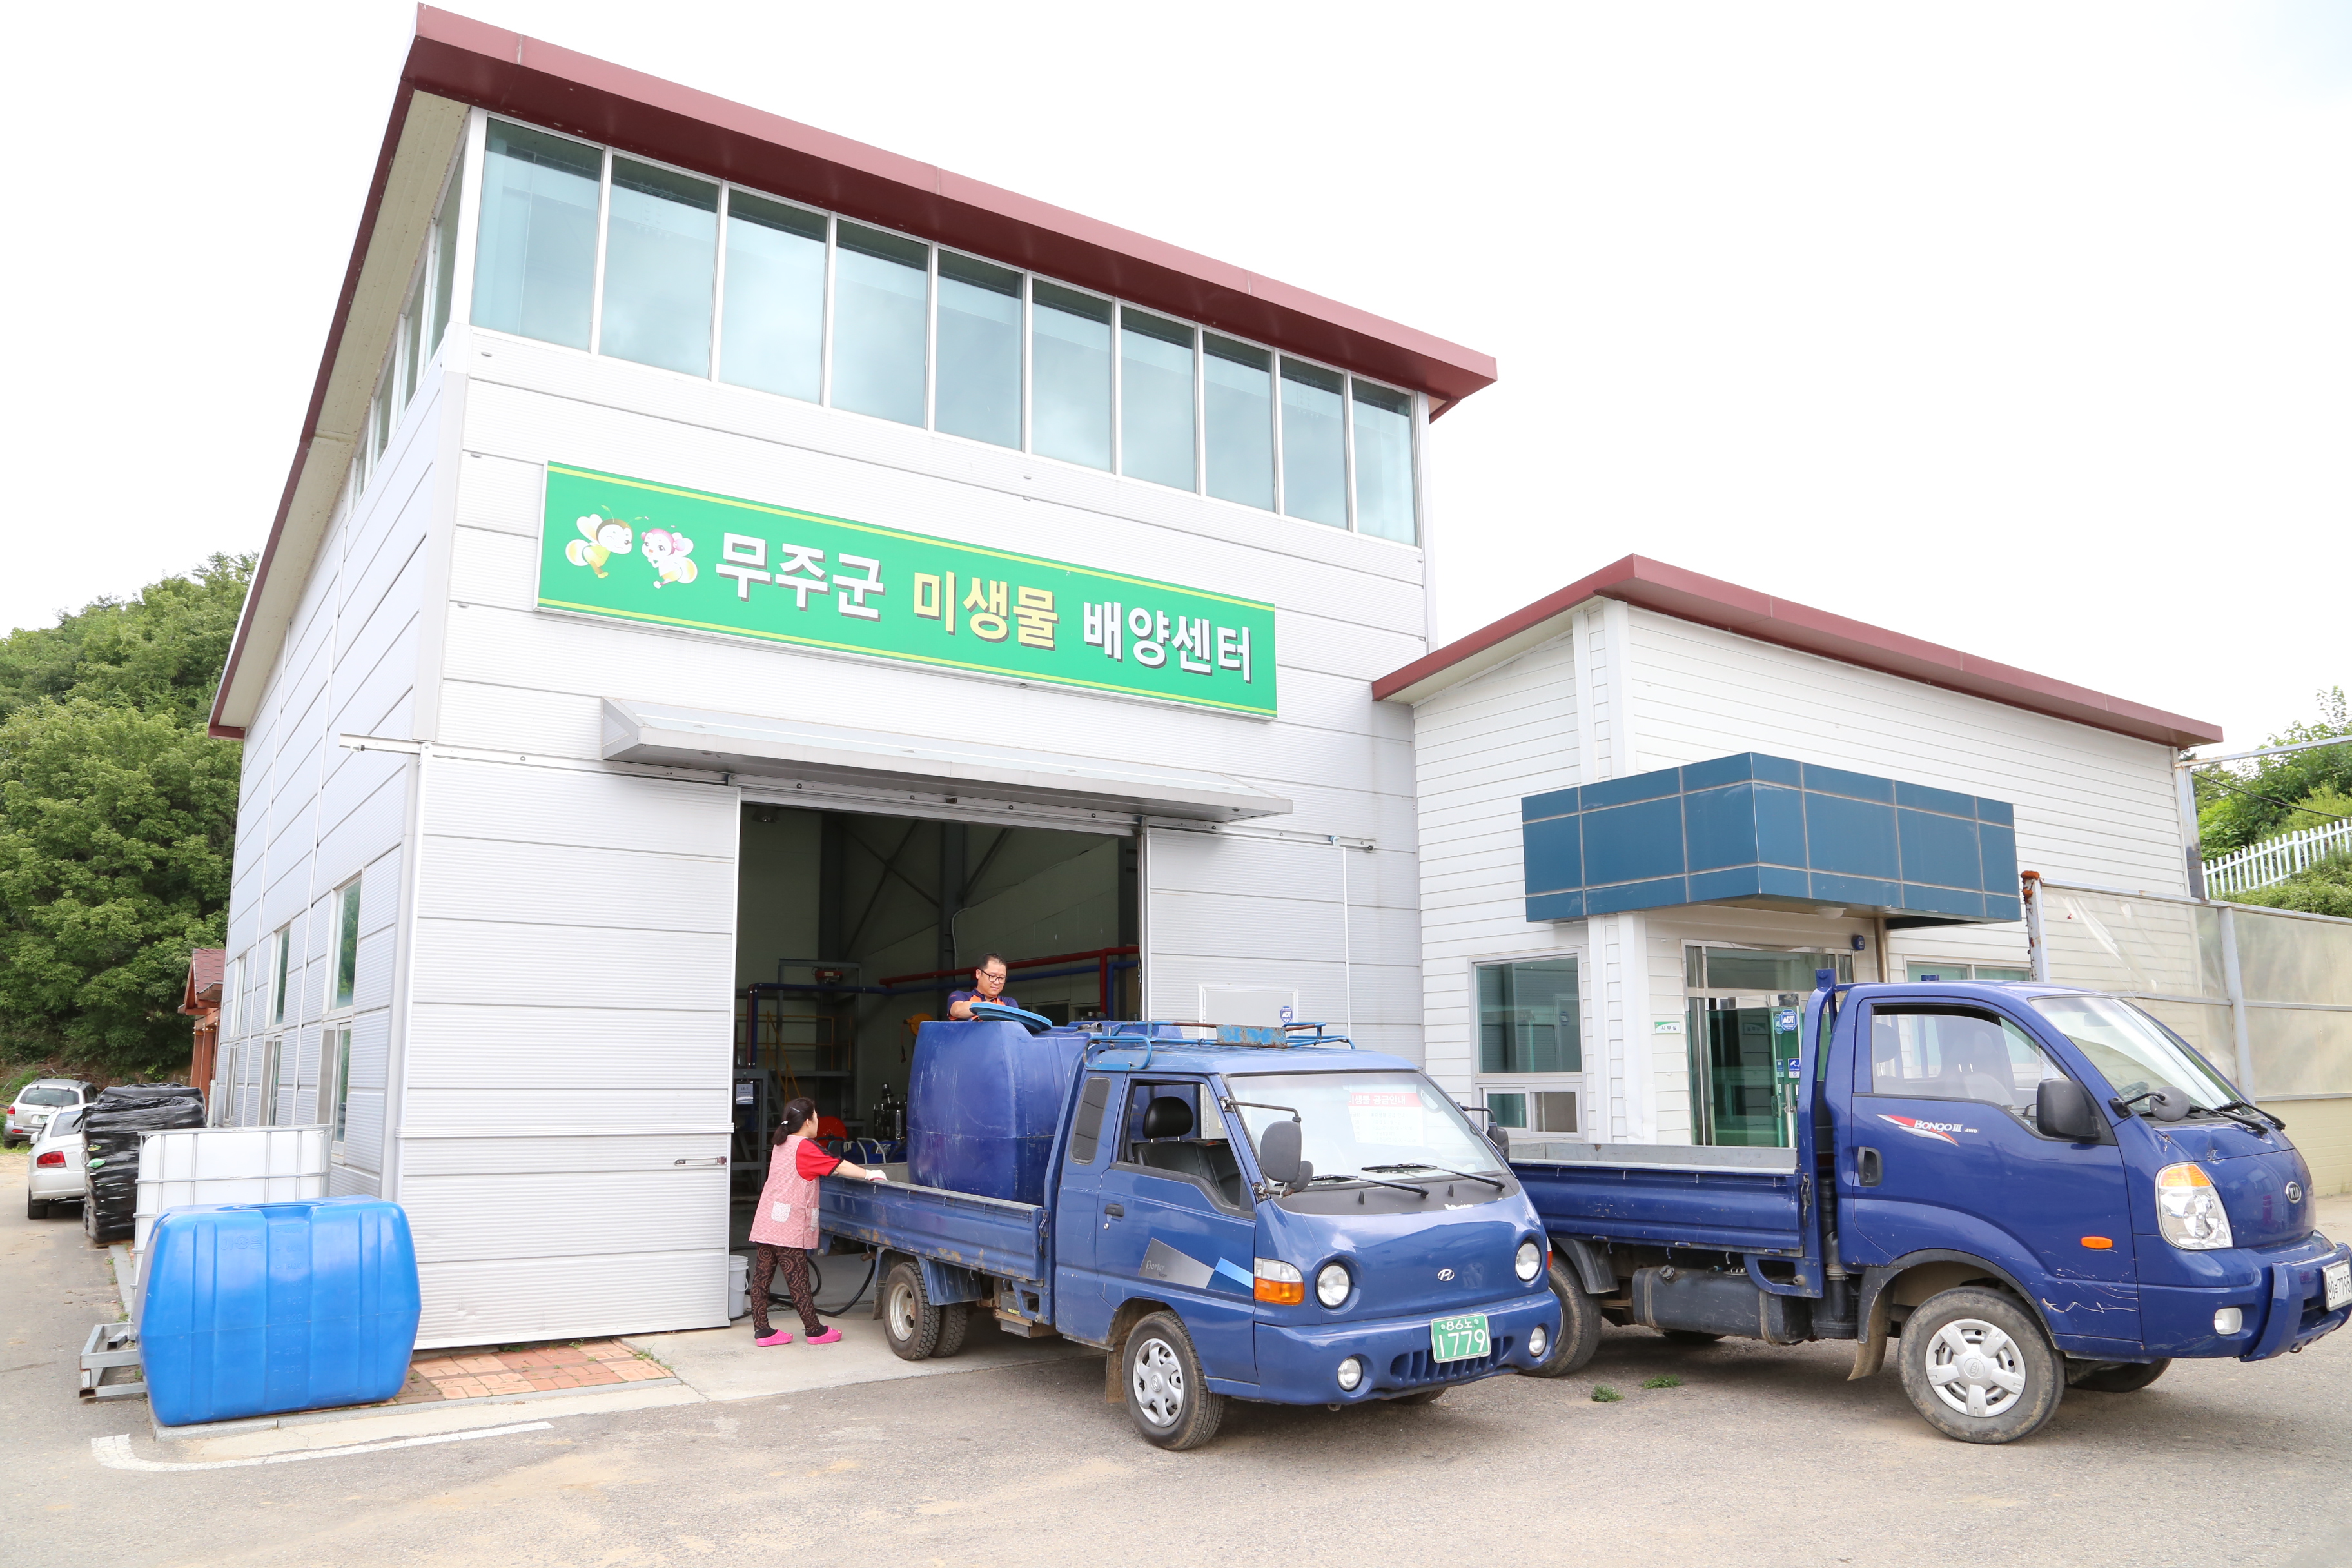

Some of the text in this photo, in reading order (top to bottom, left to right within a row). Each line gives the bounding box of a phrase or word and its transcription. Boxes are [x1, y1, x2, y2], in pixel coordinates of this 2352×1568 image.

[716, 532, 1251, 682] 무주군 미생물 배양센터
[1781, 1015, 1795, 1024] ADT
[1373, 1095, 1406, 1105] 공급안내
[1145, 1260, 1165, 1271] Porter
[1446, 1318, 1473, 1331] 86노
[1438, 1329, 1485, 1358] 1779
